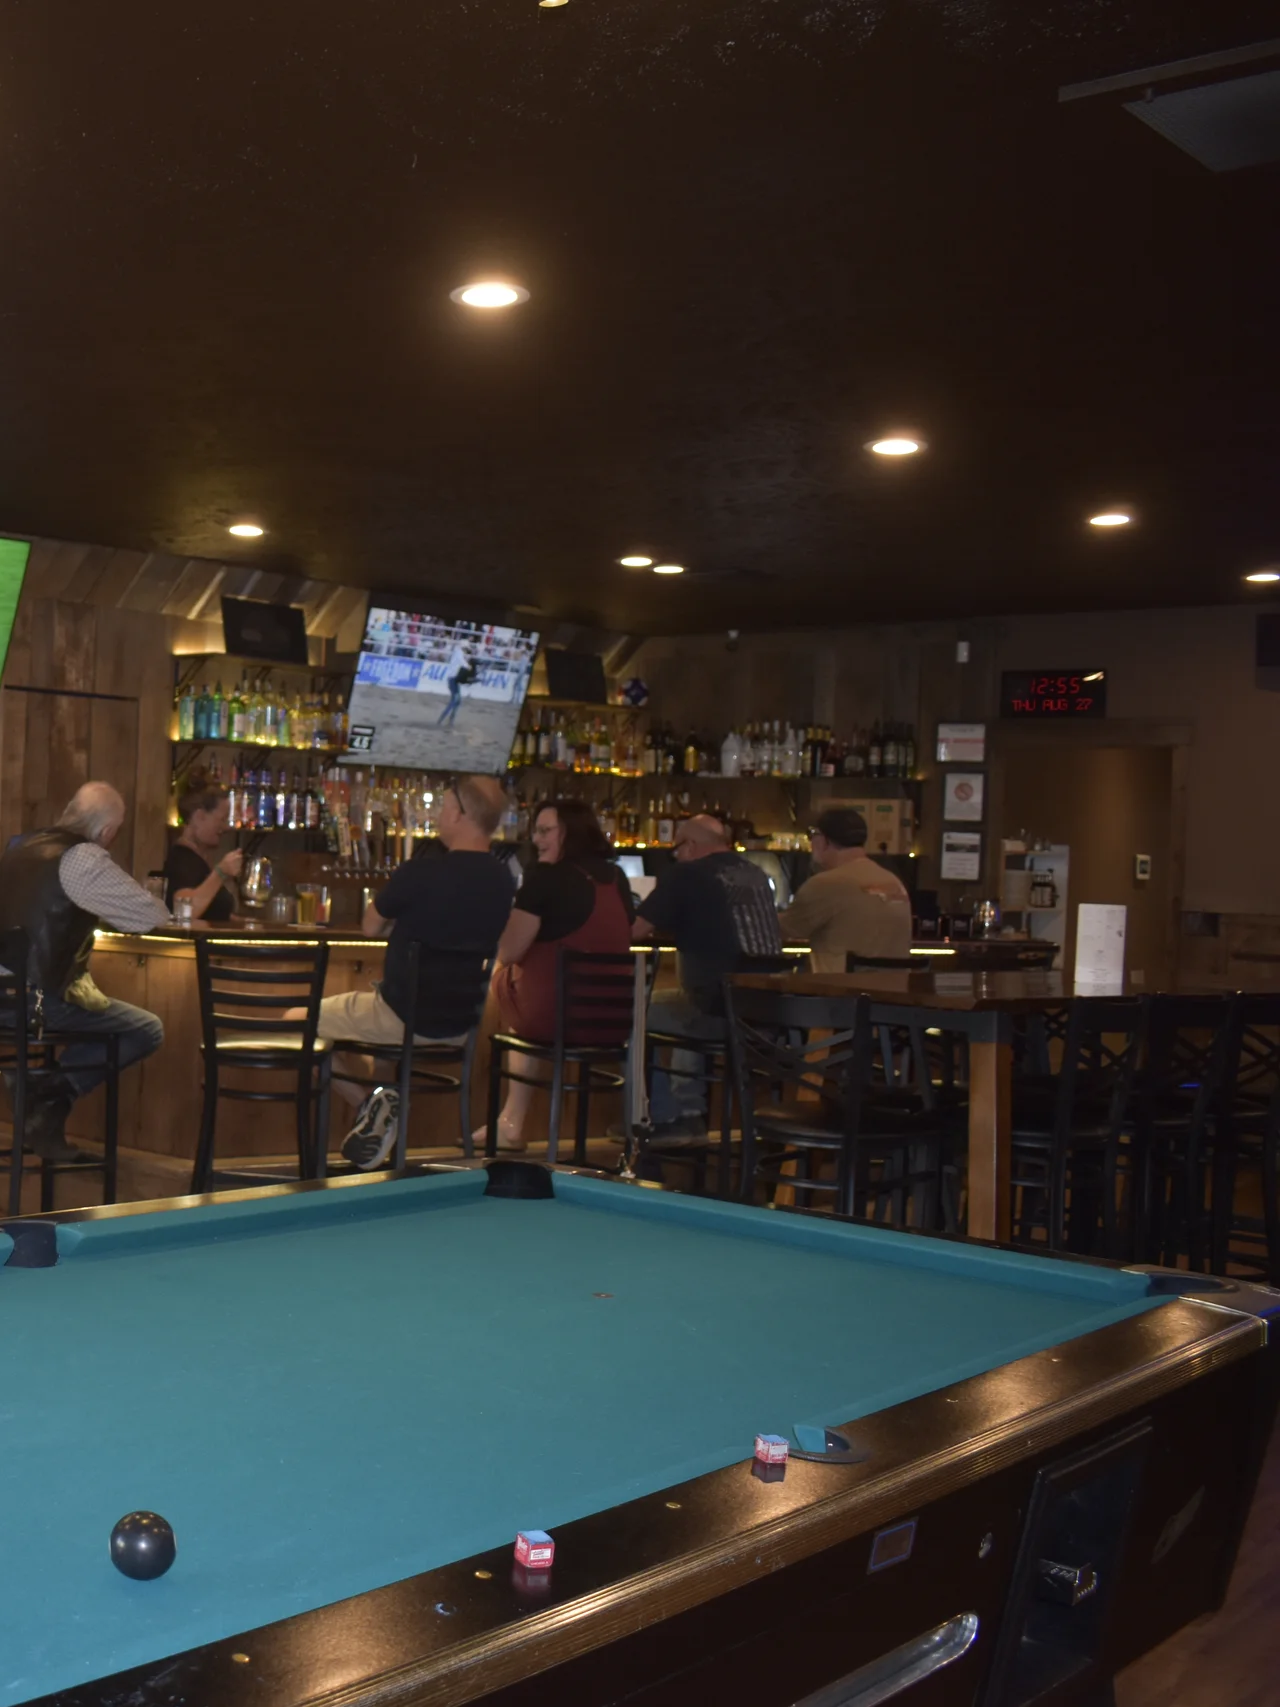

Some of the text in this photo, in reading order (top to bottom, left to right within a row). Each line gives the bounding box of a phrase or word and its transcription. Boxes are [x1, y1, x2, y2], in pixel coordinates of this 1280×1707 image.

[1030, 677, 1080, 695] 12:55
[1011, 698, 1094, 711] THU AUG 27
